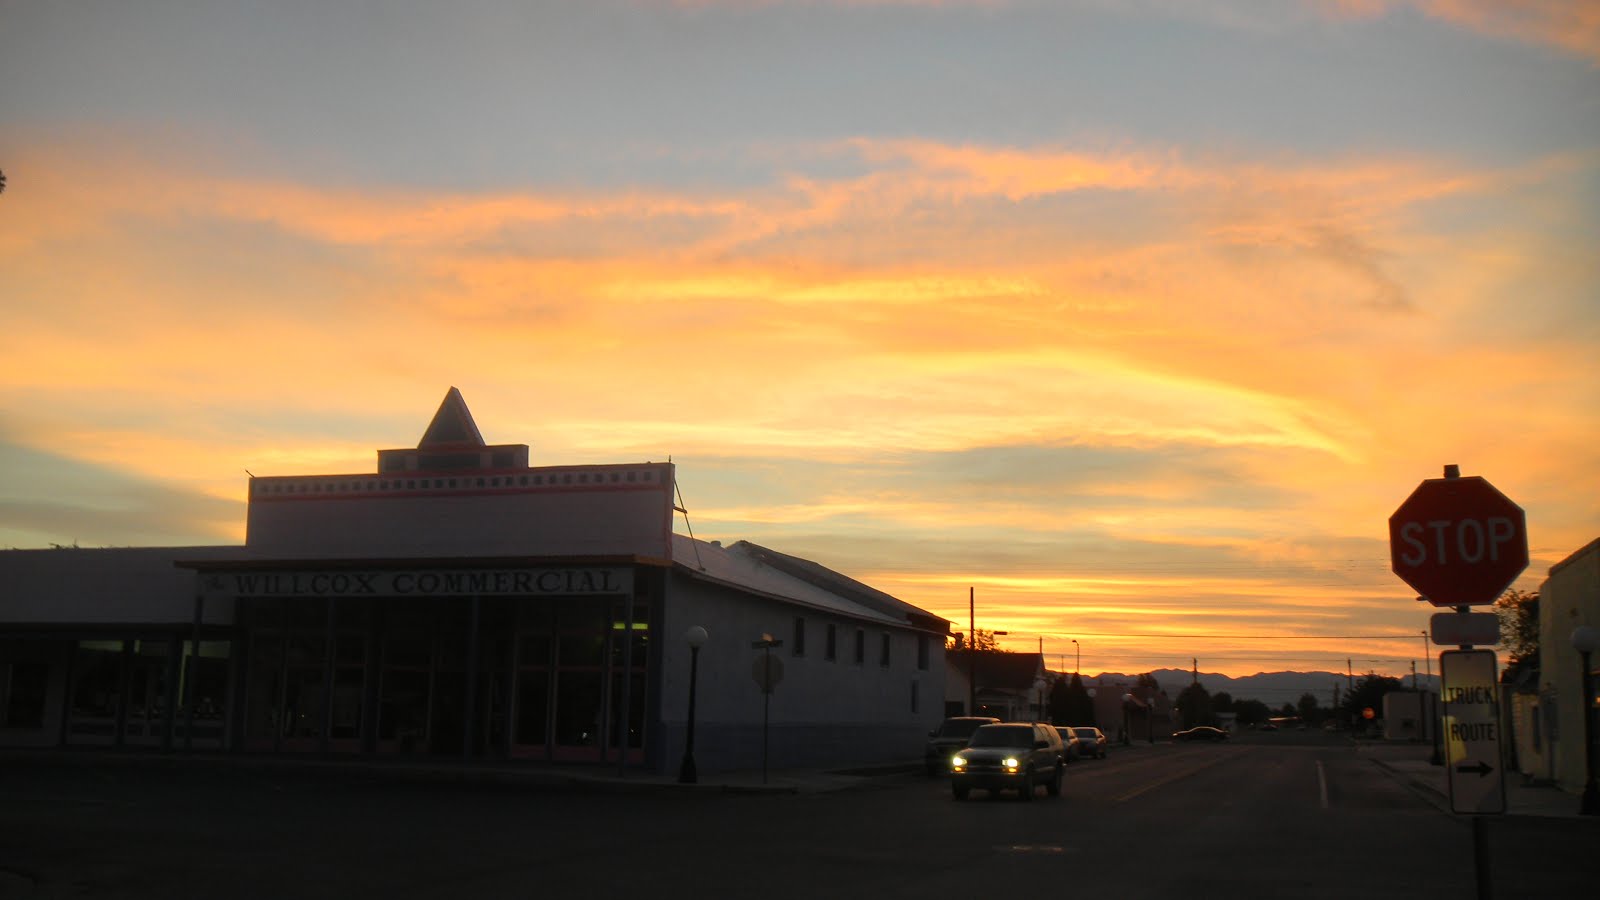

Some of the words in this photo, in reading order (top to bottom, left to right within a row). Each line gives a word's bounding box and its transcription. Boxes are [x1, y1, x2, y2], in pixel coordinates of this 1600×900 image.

[1401, 517, 1515, 566] STOP
[235, 574, 378, 594] WILLCOX
[392, 570, 621, 594] COMMERCIAL
[1448, 687, 1493, 704] TRUCK
[1451, 723, 1496, 741] ROUTE
